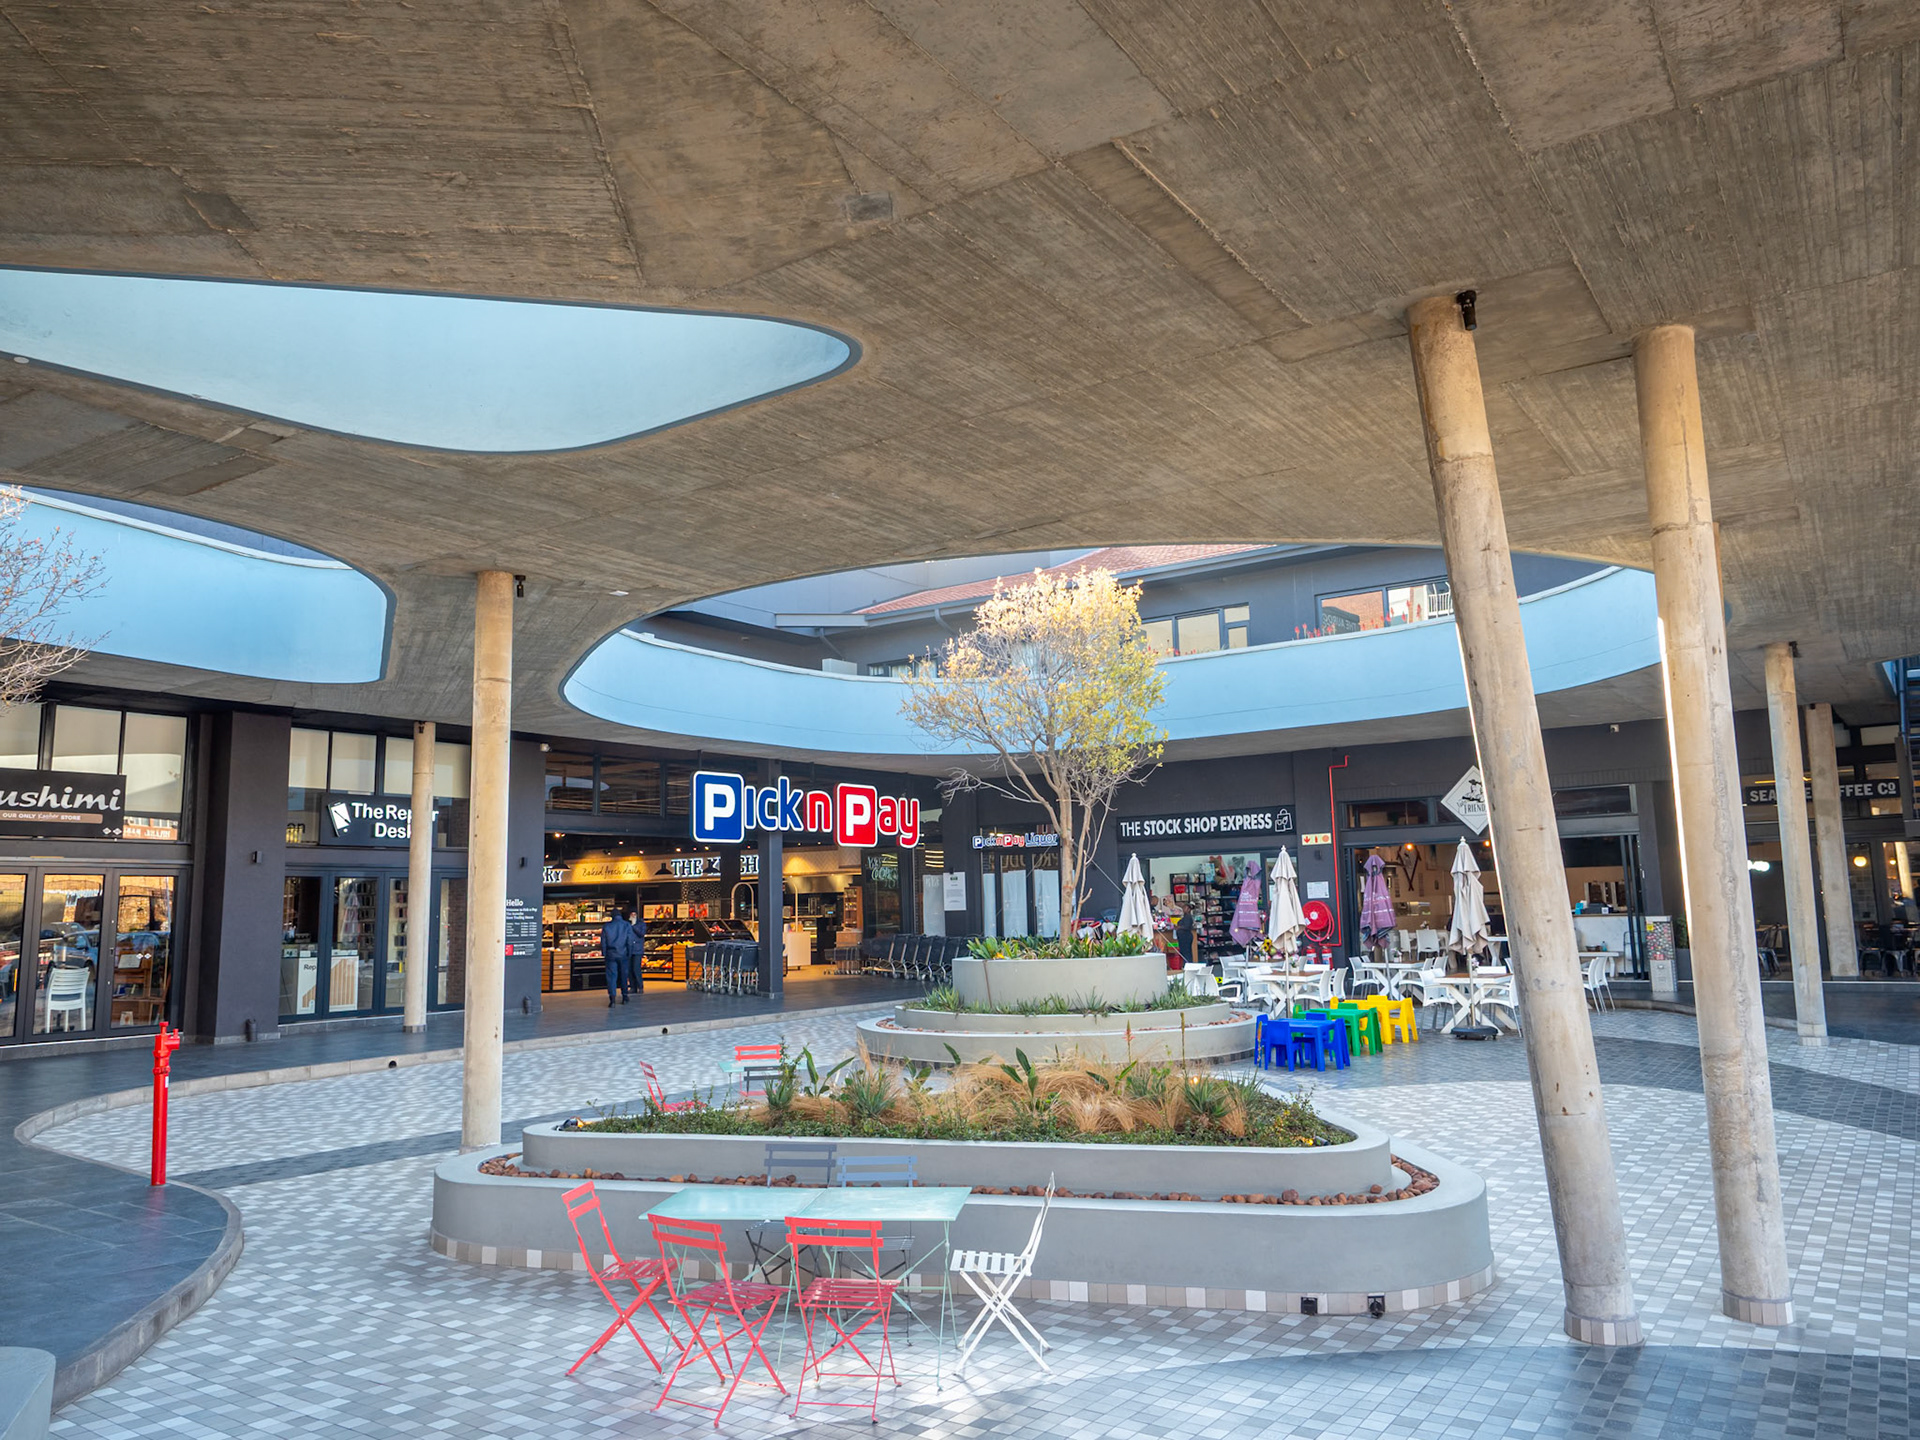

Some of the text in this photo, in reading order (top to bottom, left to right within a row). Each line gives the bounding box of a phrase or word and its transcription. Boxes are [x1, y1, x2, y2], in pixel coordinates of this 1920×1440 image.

[1750, 787, 1813, 802] SEAE
[351, 803, 439, 824] The Repr
[836, 783, 920, 848] Pay
[1120, 812, 1273, 837] THE STOCK SHOP EXPRESS
[1025, 832, 1058, 847] Liquor
[671, 858, 704, 877] THE
